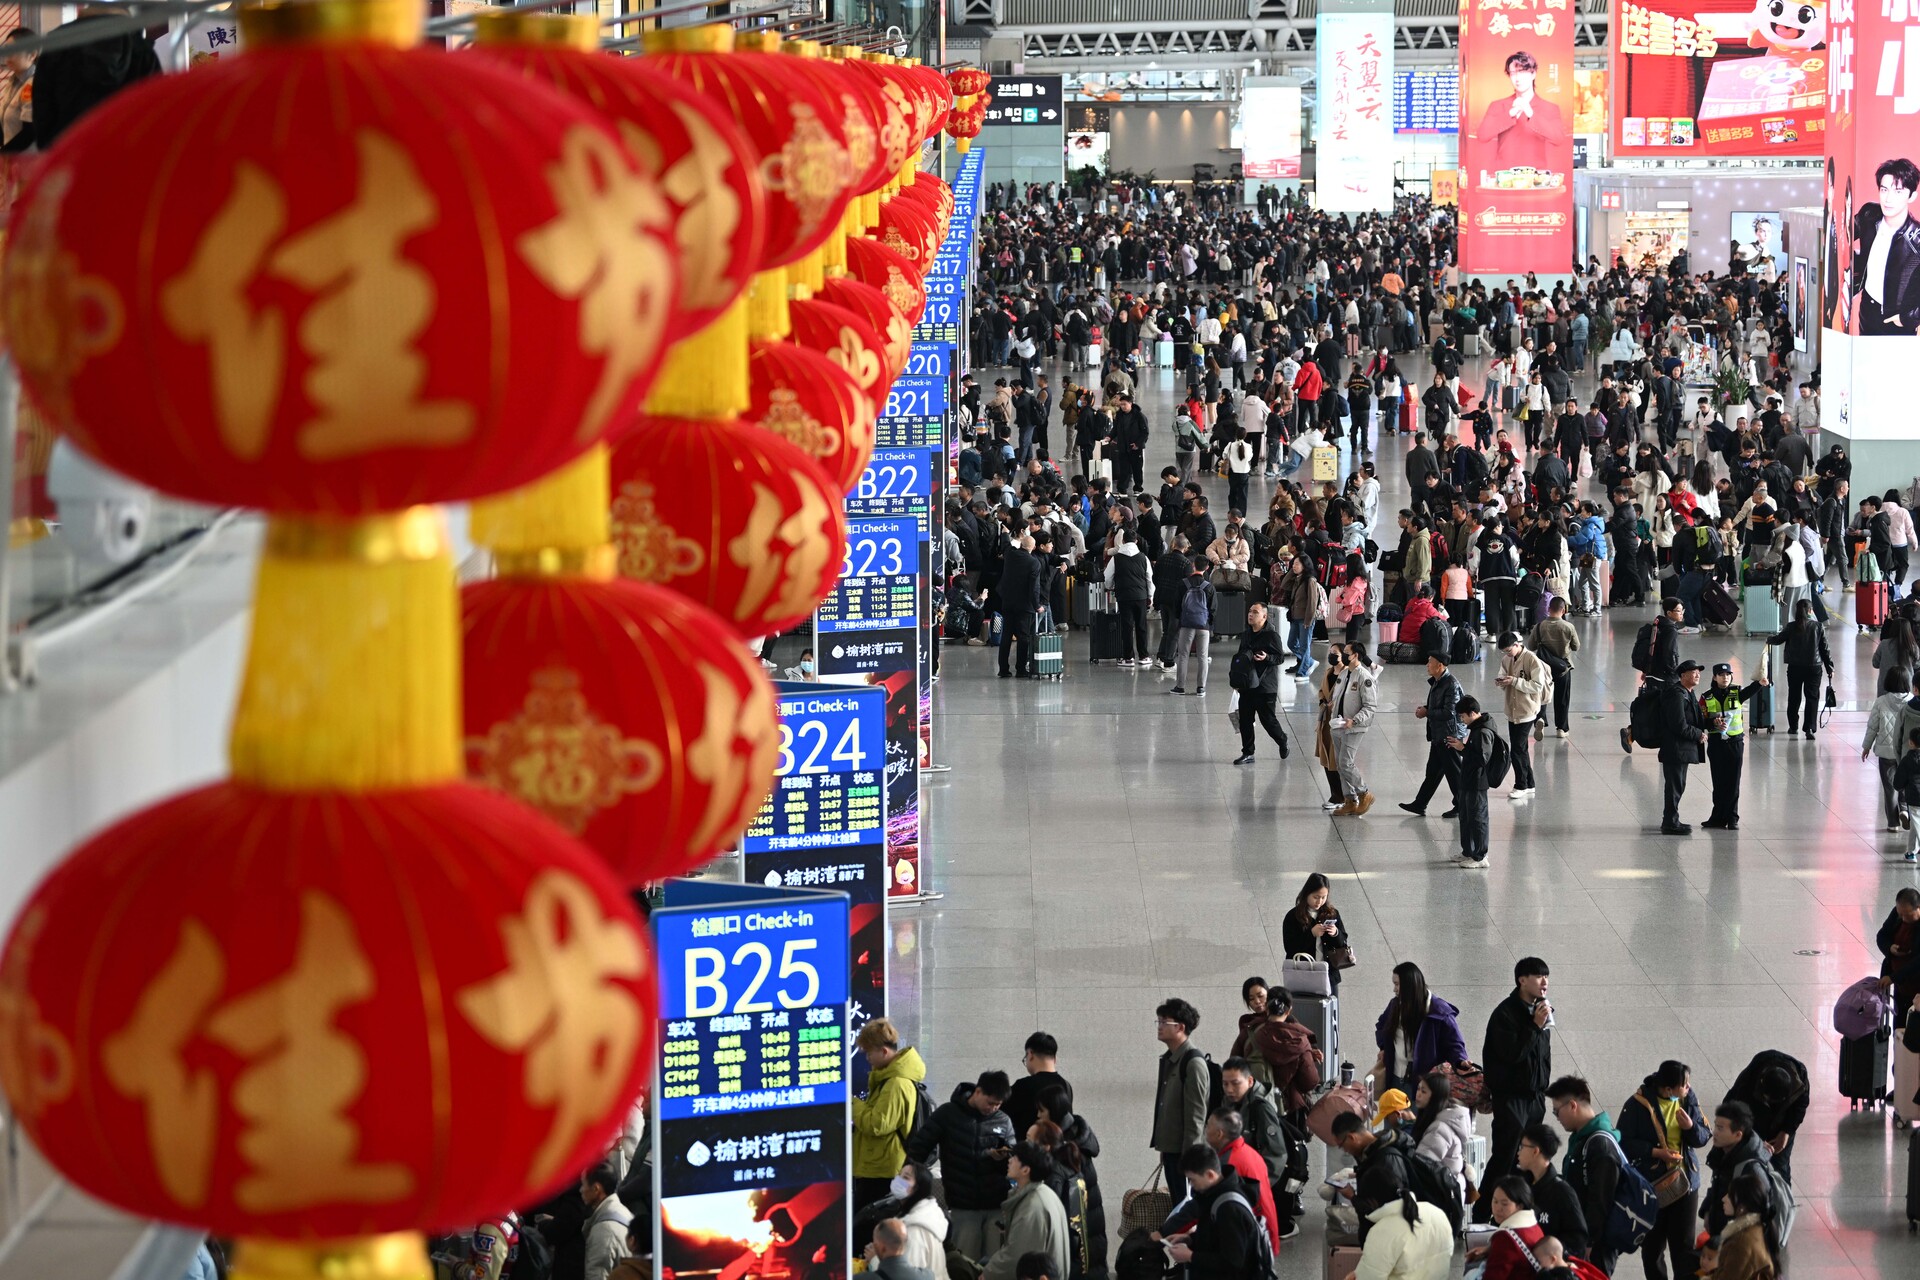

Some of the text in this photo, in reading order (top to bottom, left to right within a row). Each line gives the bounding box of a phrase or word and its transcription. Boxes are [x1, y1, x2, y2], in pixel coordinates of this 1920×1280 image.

[1488, 12, 1556, 38] 每一面
[1620, 0, 1718, 57] 送喜多多
[1355, 32, 1382, 122] 天翼云
[1005, 107, 1022, 117] 出口
[1705, 126, 1754, 143] 送喜多多
[885, 390, 929, 417] B21
[884, 452, 915, 460] Check-in
[858, 465, 918, 499] B22
[912, 497, 924, 505] 状态
[863, 523, 899, 533] Check-in
[844, 576, 910, 587] 终到站 开点 状态
[891, 602, 914, 610] 正在候车
[891, 610, 914, 618] 正在候车
[835, 619, 900, 630] 开车前4分钟停止检票
[846, 642, 884, 657] 榆树湾
[808, 698, 859, 713] Check-in
[781, 773, 874, 789] 终到站 开点 状态
[819, 789, 842, 799] 10:43
[848, 786, 880, 797] 正在检票
[819, 800, 842, 810] 10:57
[848, 797, 880, 808] 正在候车
[819, 812, 842, 821] 11:06
[848, 808, 880, 820] 正在候车
[819, 822, 842, 832] 11:36
[848, 820, 880, 830] 正在候车
[769, 832, 860, 849] 开车前4分钟停止检票
[784, 865, 838, 886] 榆树湾
[691, 910, 813, 937] 检票口 Check-in
[685, 939, 820, 1018] B25
[667, 1007, 834, 1037] 车次 终到站 开点 状态
[798, 1026, 841, 1042] 正在检票
[761, 1045, 790, 1059] 10:57
[798, 1040, 841, 1057] 正在候车
[761, 1060, 791, 1073] 11:06
[798, 1055, 841, 1072] 正在候车
[798, 1070, 841, 1086] 正在候车
[692, 1088, 815, 1114] 开车前4分钟停止检票
[713, 1133, 785, 1162] 榆树湾
